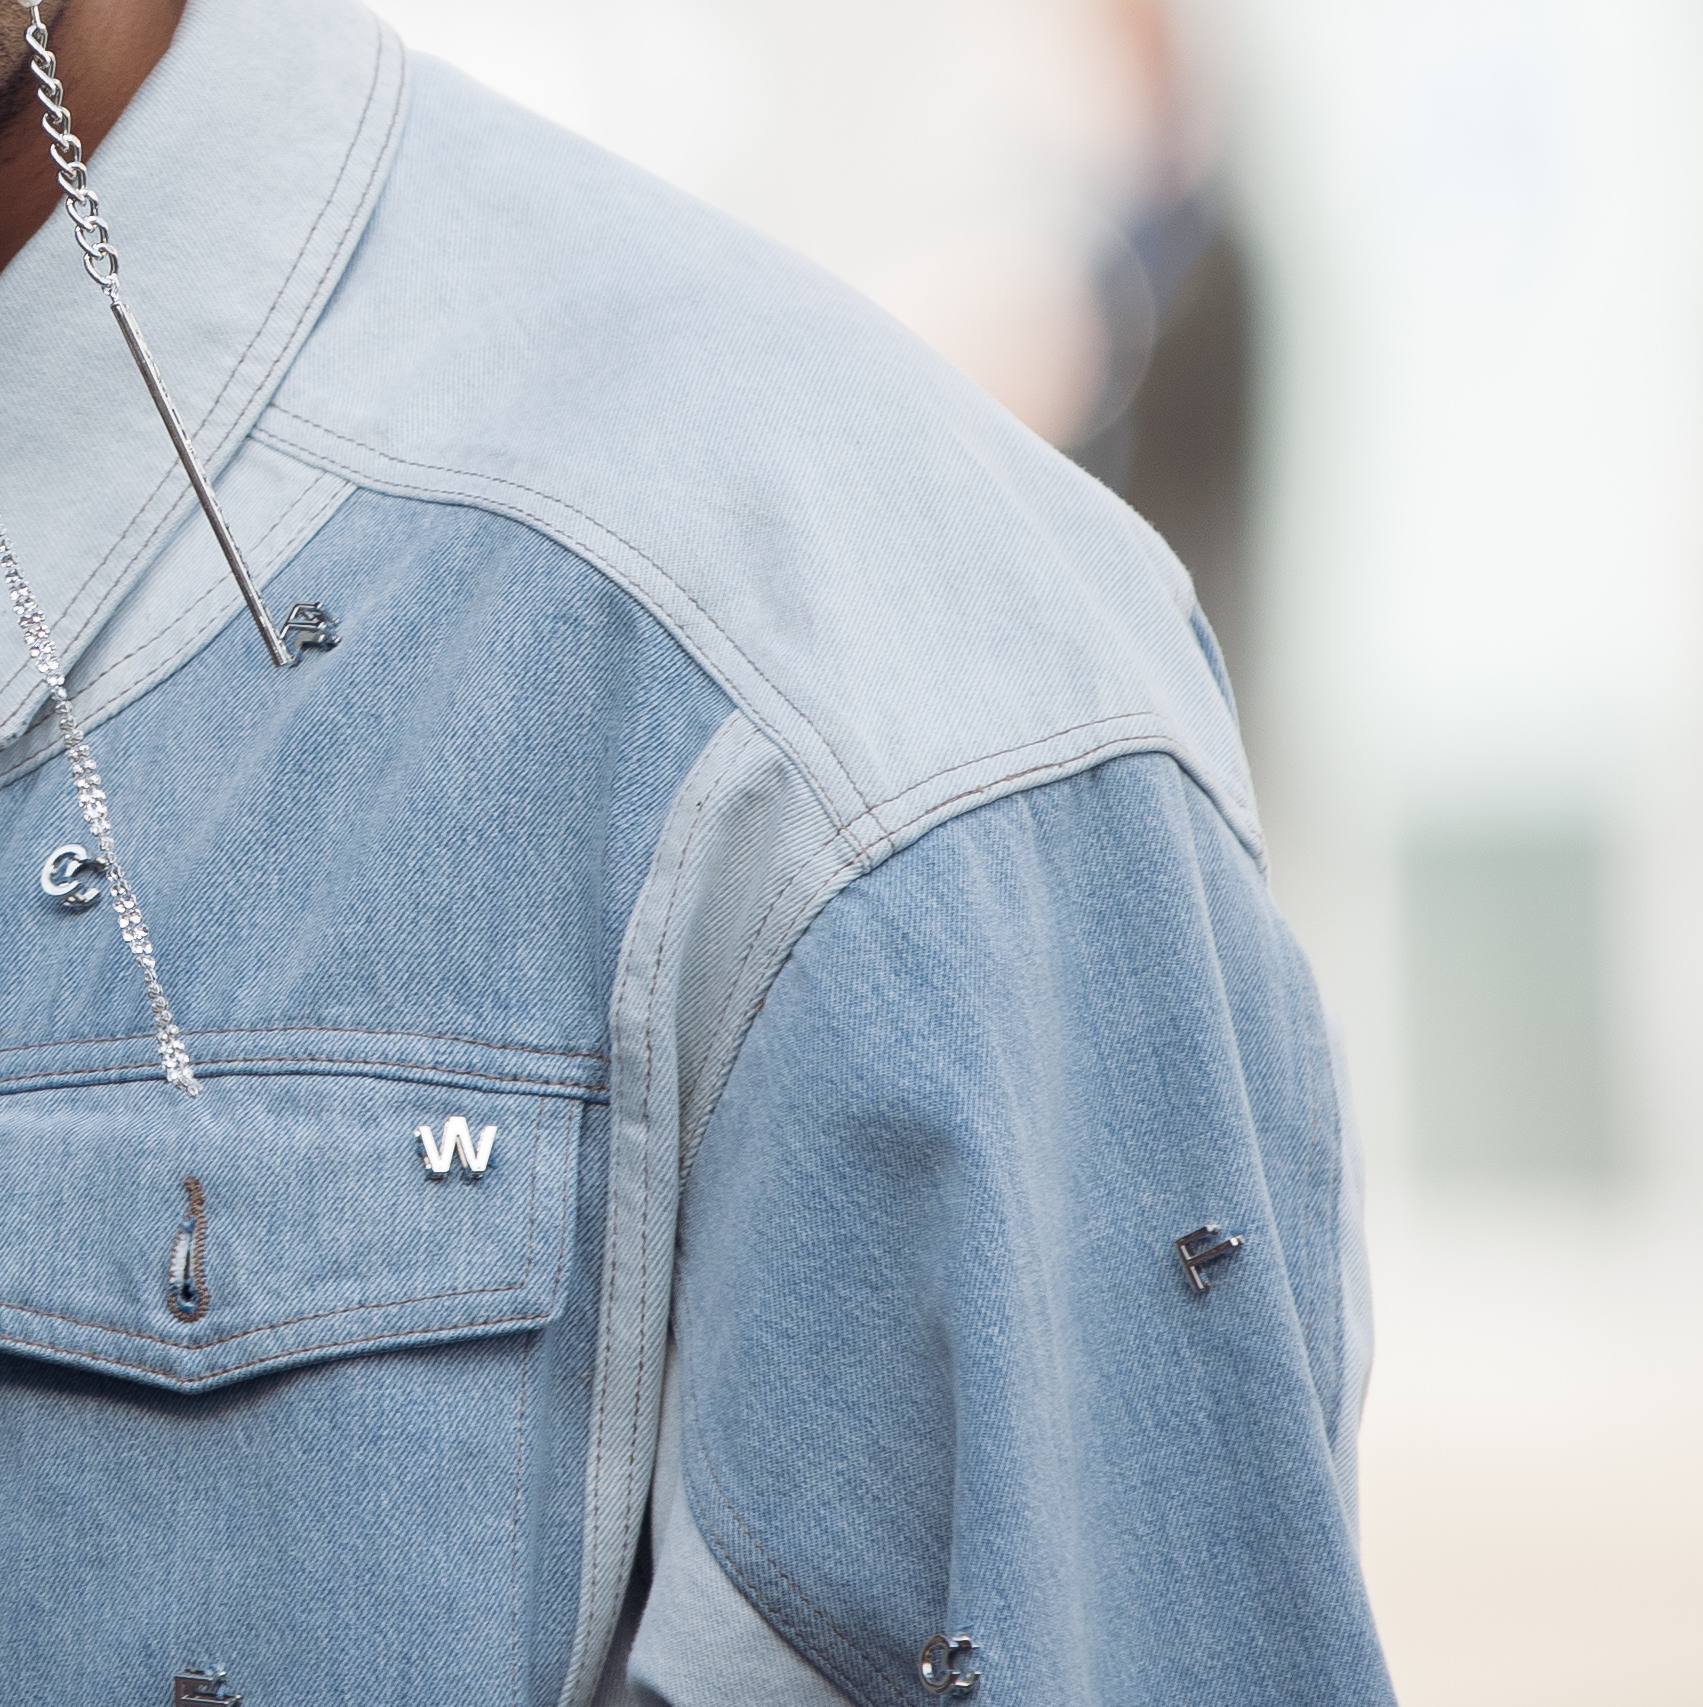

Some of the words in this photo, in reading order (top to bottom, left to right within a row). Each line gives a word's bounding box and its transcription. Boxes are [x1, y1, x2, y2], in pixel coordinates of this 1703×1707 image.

[41, 843, 95, 903] C
[414, 1115, 498, 1175] W
[1175, 1223, 1245, 1294] F
[919, 1634, 980, 1695] C
